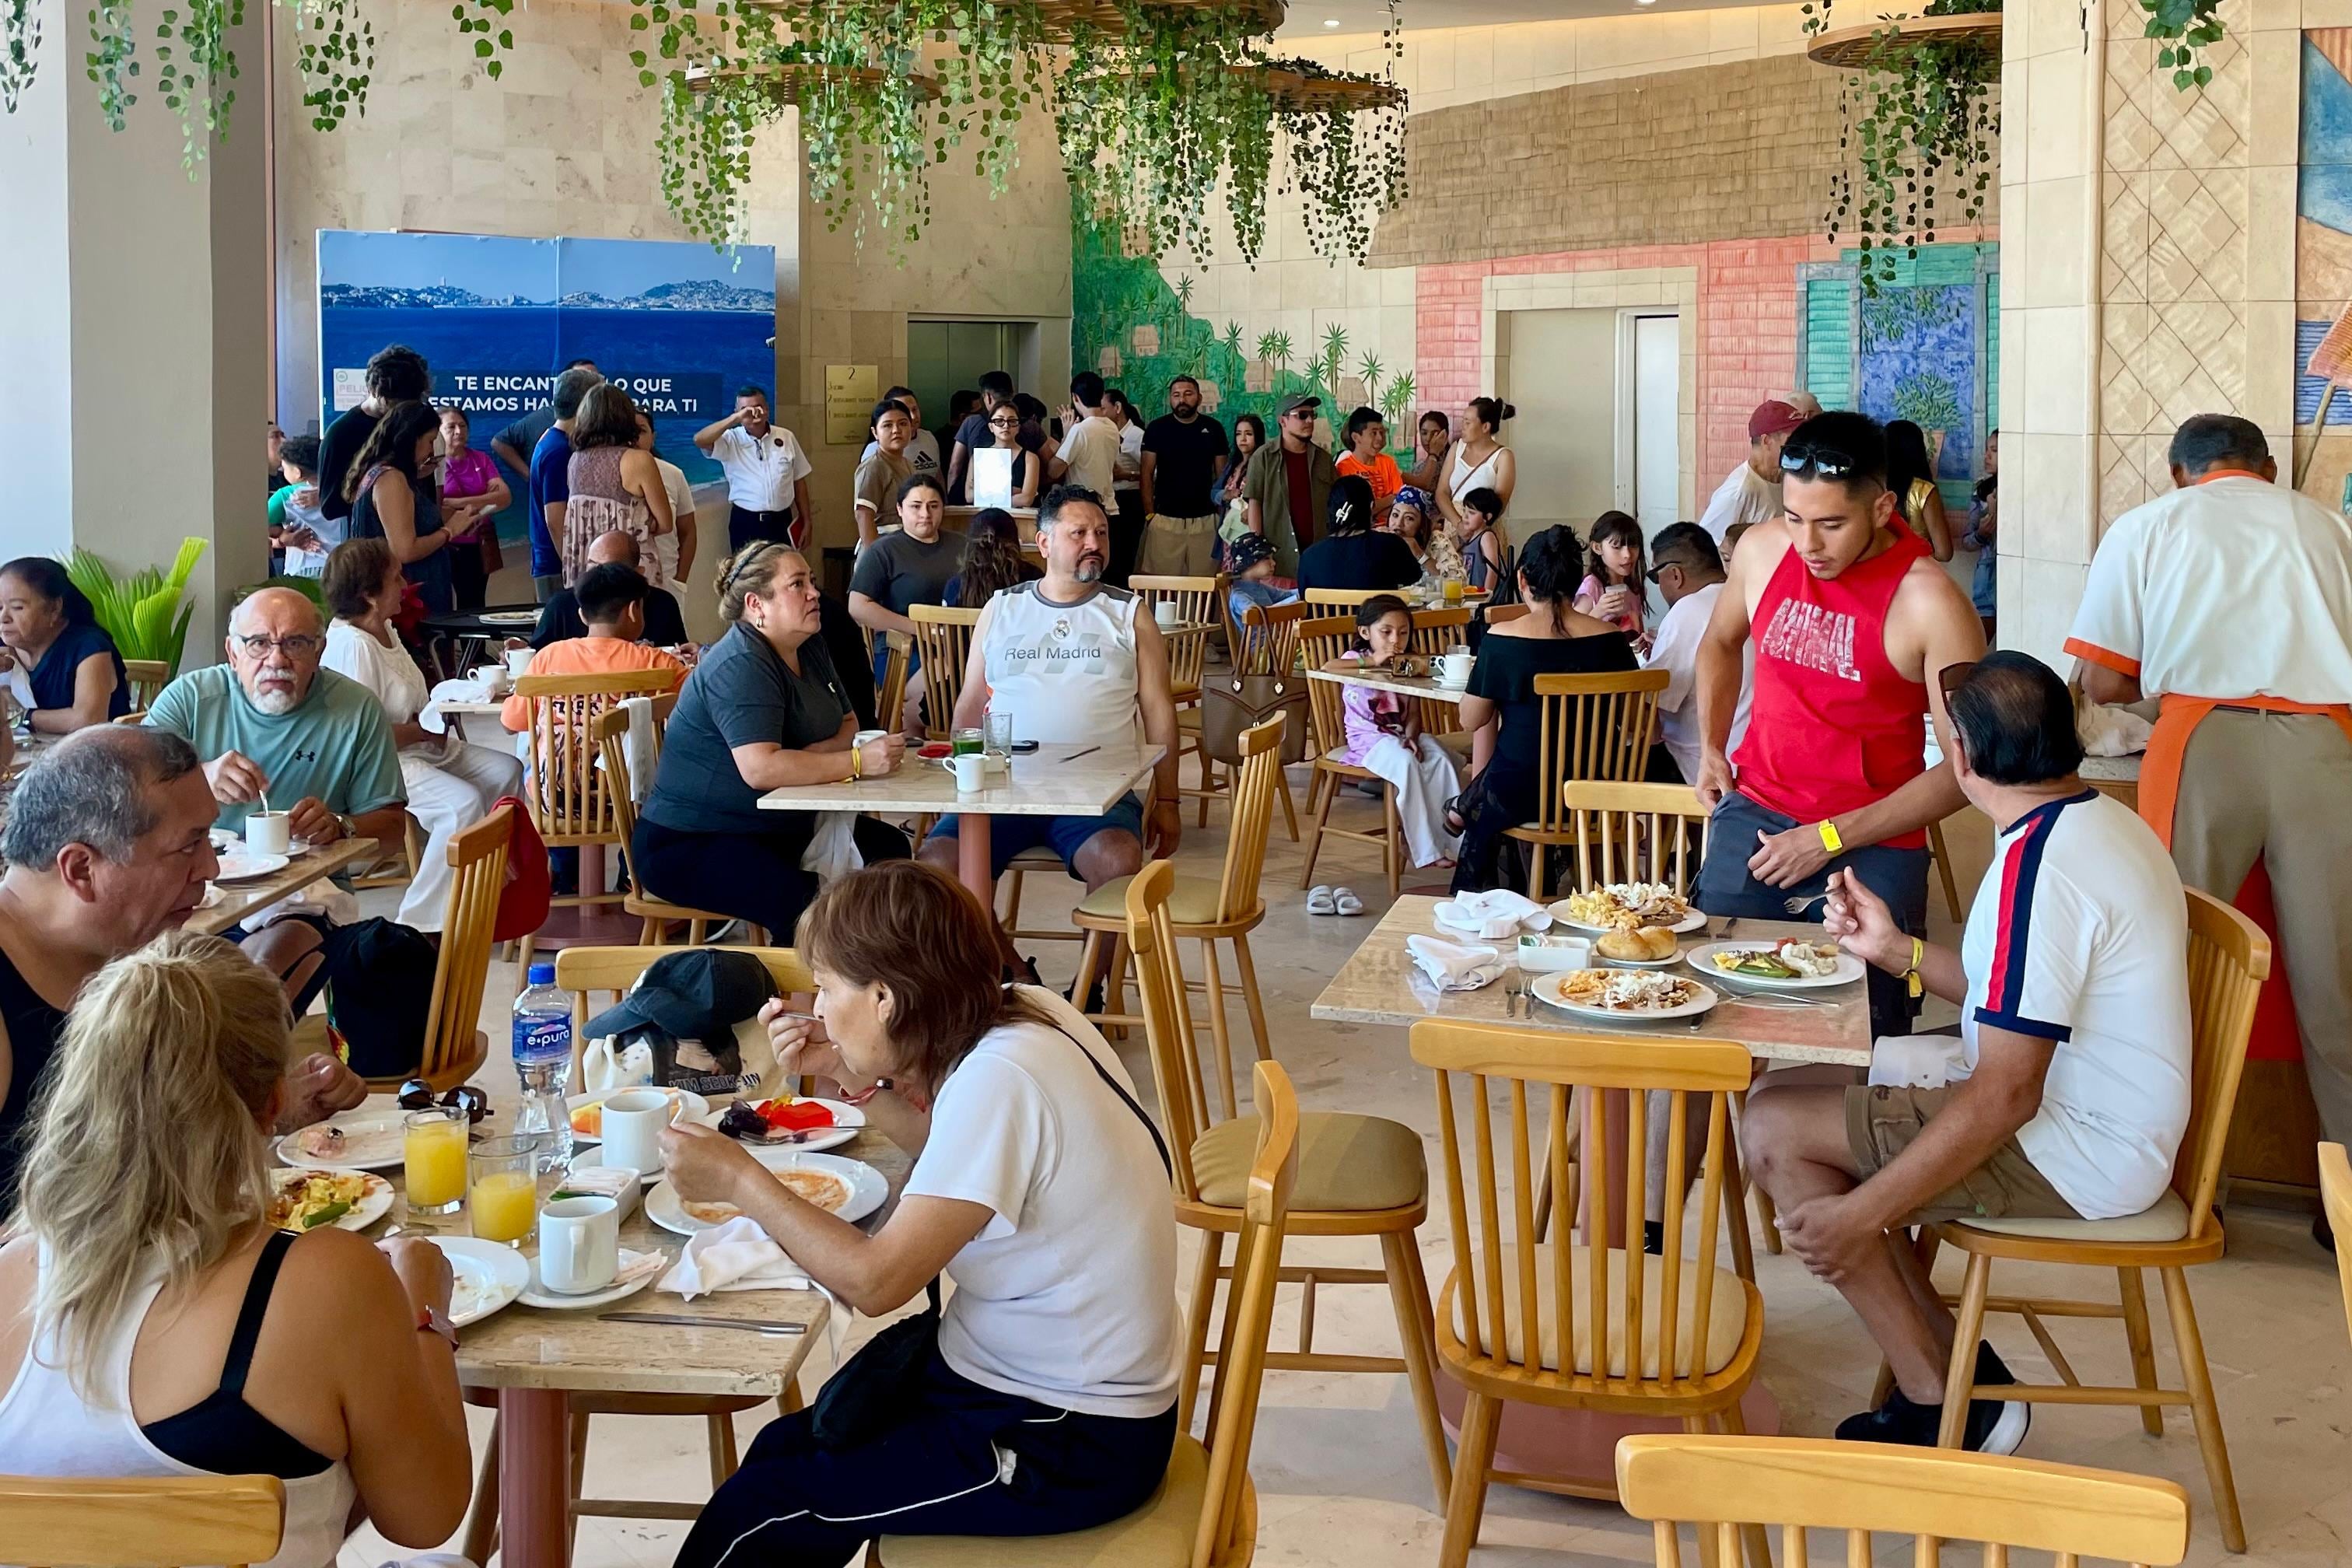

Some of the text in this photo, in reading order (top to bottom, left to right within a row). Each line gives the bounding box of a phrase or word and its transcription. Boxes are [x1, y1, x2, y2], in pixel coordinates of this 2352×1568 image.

[848, 366, 856, 380] 2
[454, 376, 478, 390] TE
[484, 376, 558, 390] ENCANT
[633, 378, 672, 394] QUE
[428, 397, 519, 411] ESTAMOS
[682, 398, 697, 412] TI
[1004, 646, 1101, 661] Real Madrid
[669, 1076, 699, 1092] KIM
